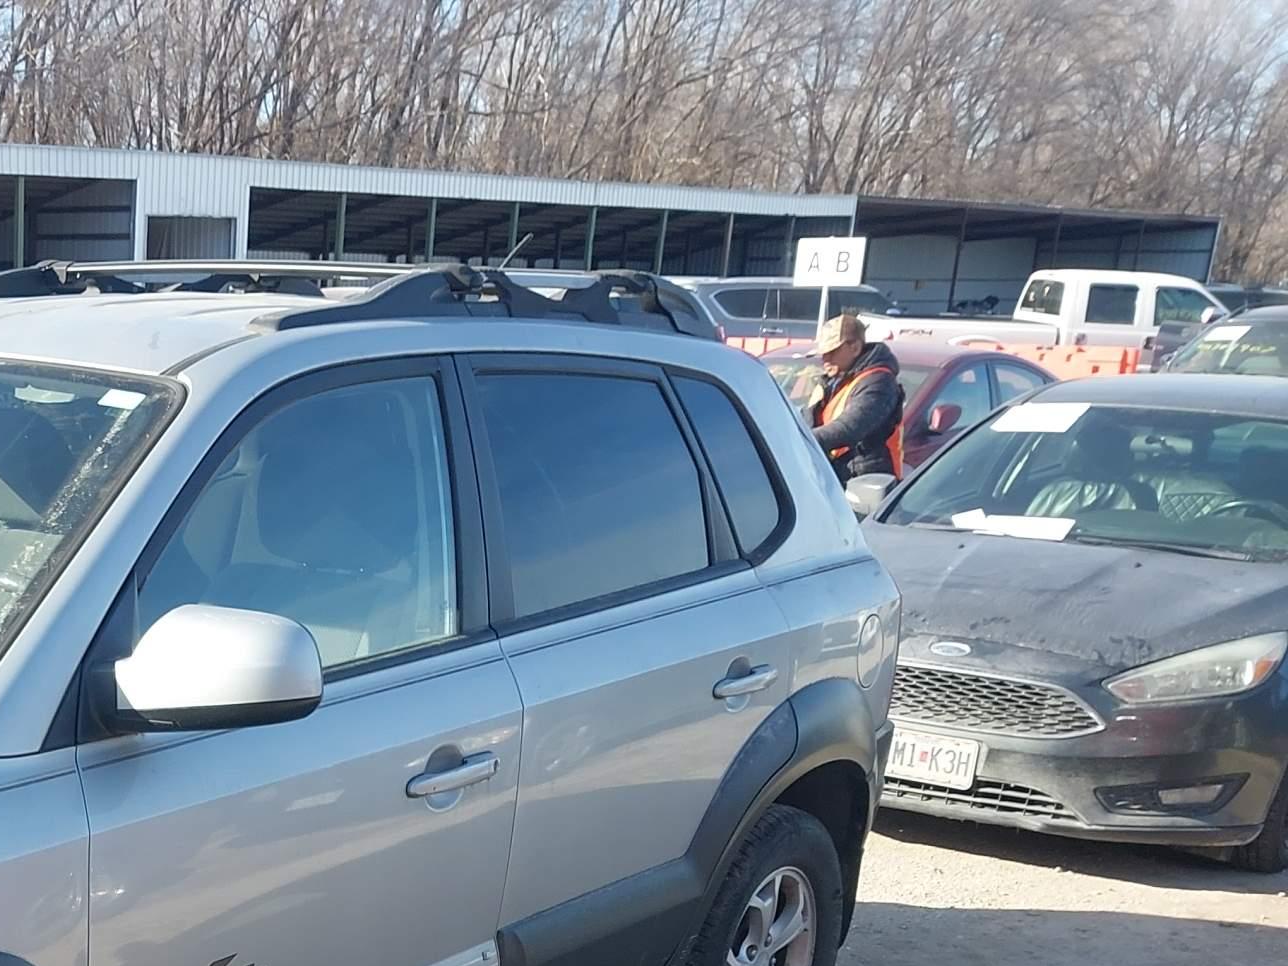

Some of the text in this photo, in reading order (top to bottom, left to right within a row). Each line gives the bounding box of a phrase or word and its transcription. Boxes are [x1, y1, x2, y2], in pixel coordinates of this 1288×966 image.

[807, 251, 850, 273] A B
[928, 746, 971, 777] K3H
